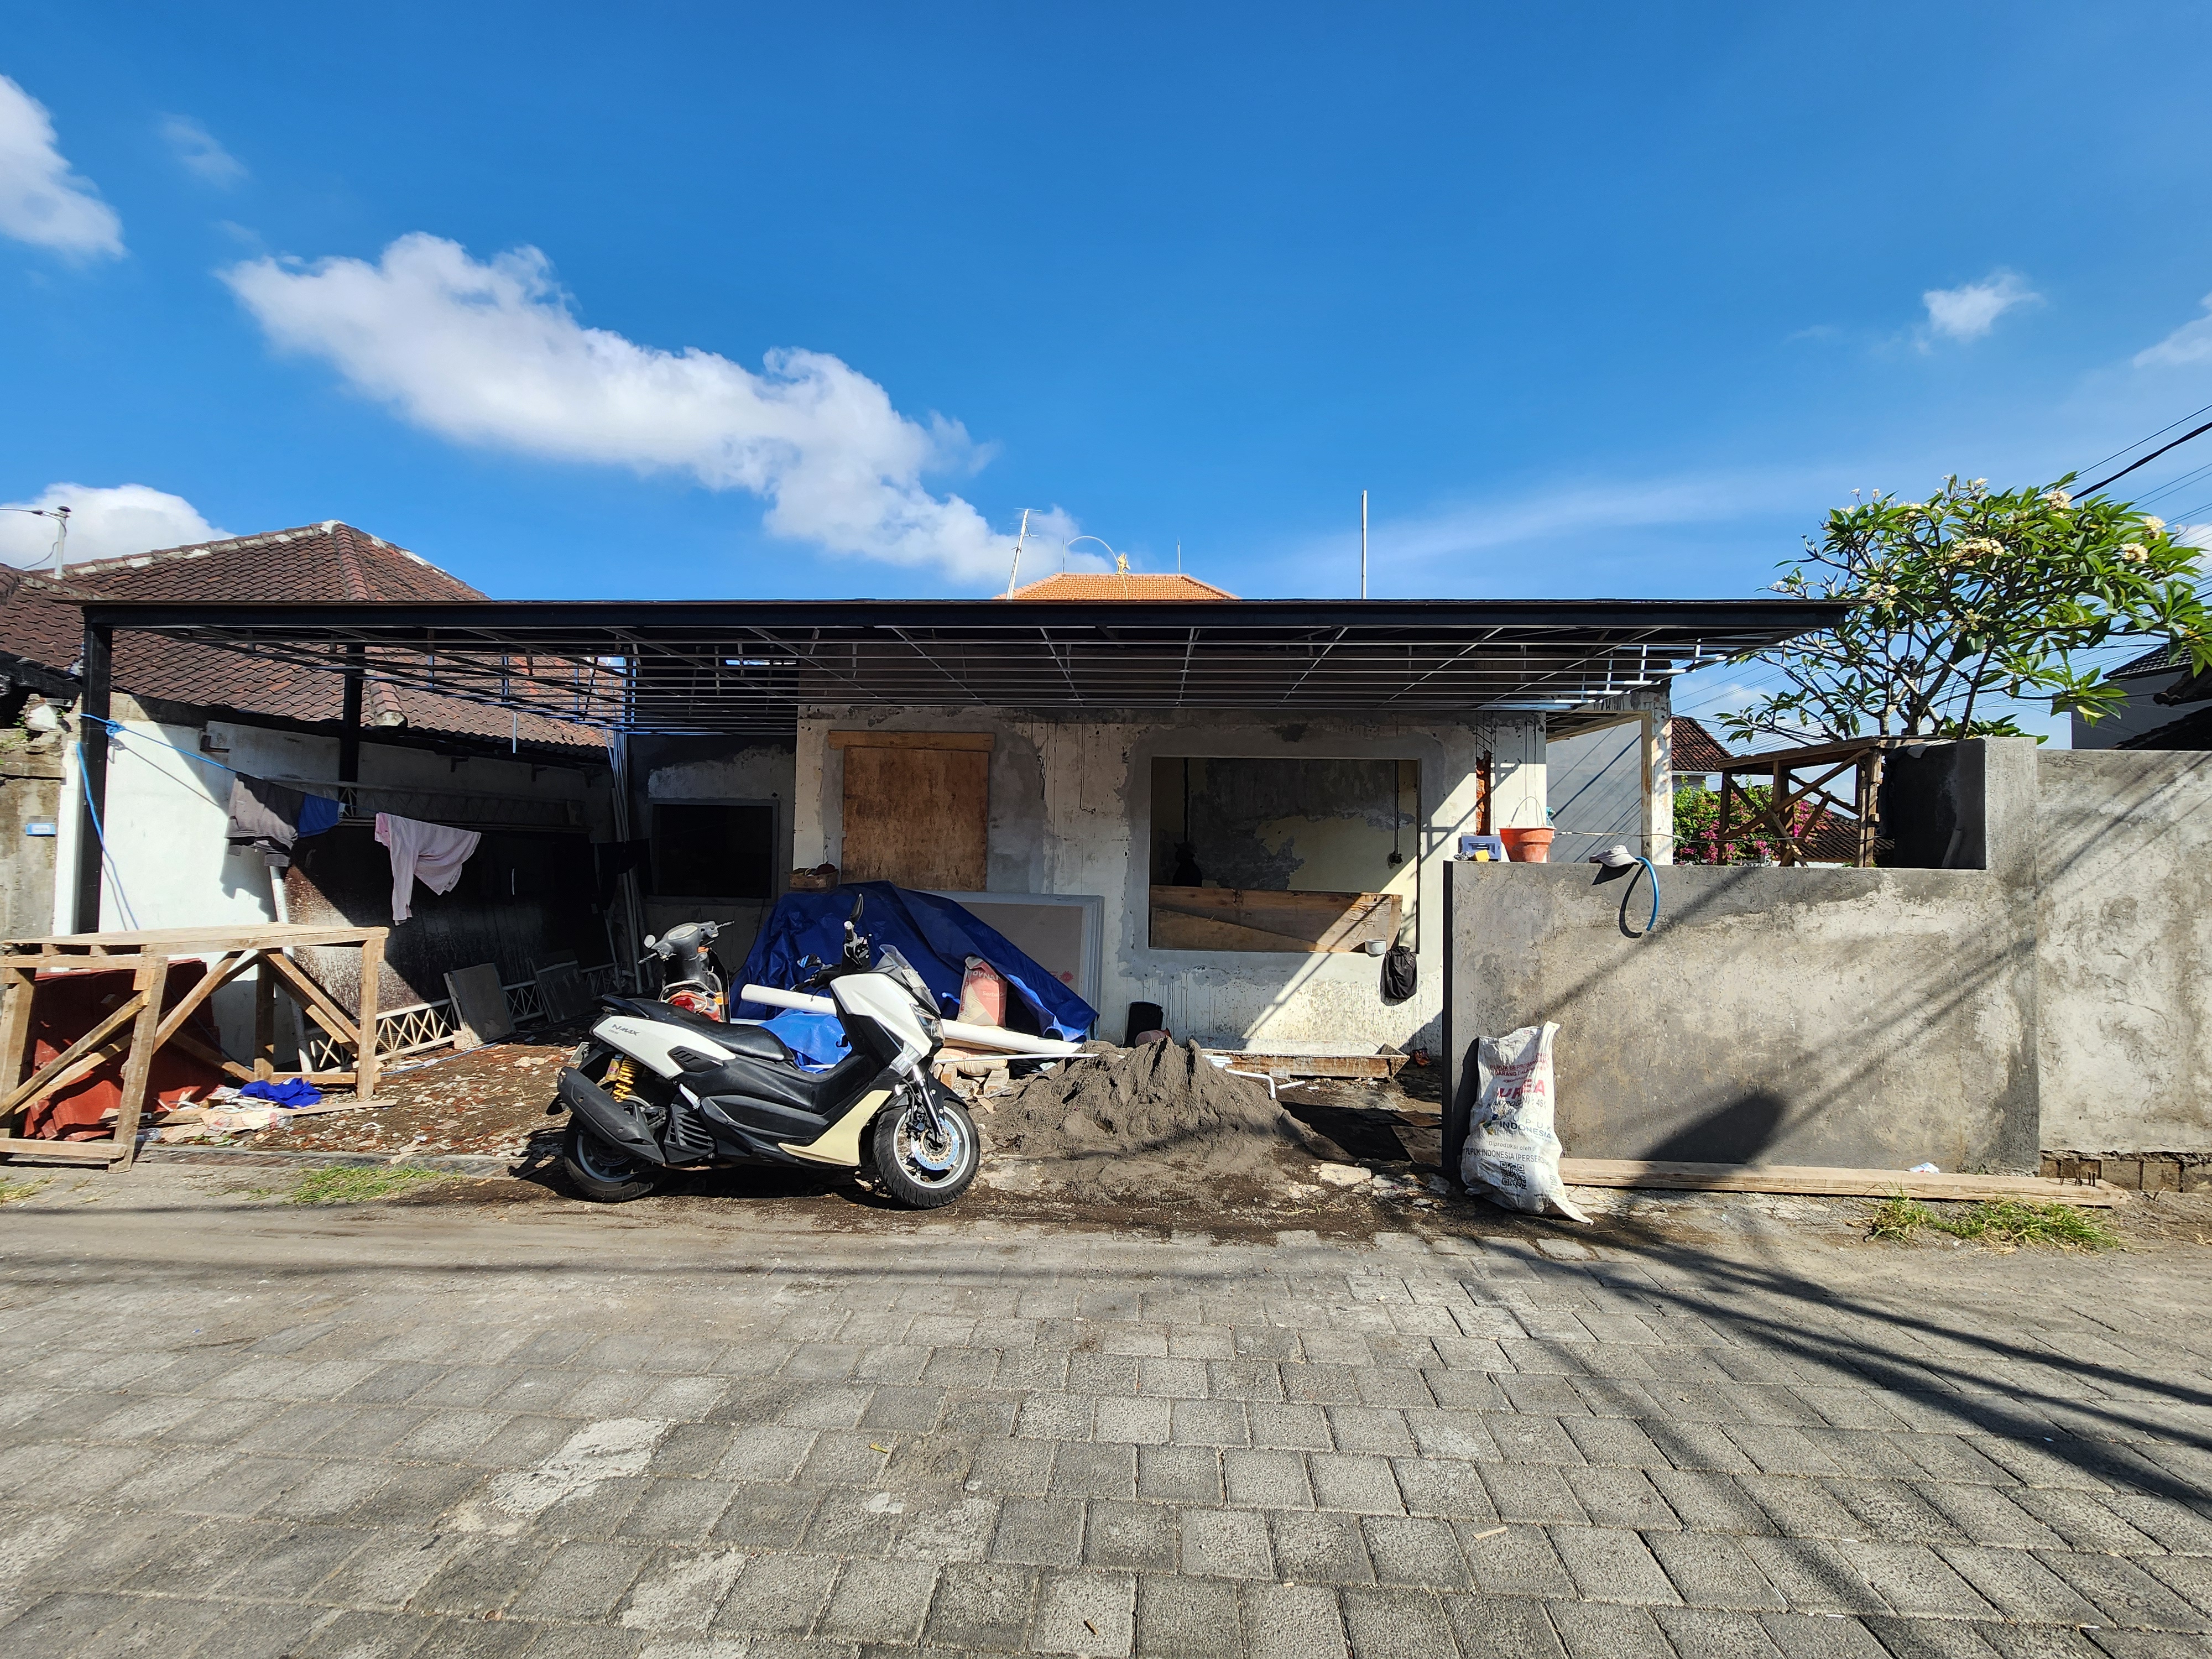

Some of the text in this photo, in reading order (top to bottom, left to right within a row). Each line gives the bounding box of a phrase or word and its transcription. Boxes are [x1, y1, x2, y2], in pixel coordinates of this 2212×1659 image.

[612, 1024, 640, 1036] NMAX
[1499, 1120, 1552, 1139] INDONESIA
[1488, 1140, 1519, 1150] Diproduksi
[1481, 1149, 1515, 1160] INDONESIA
